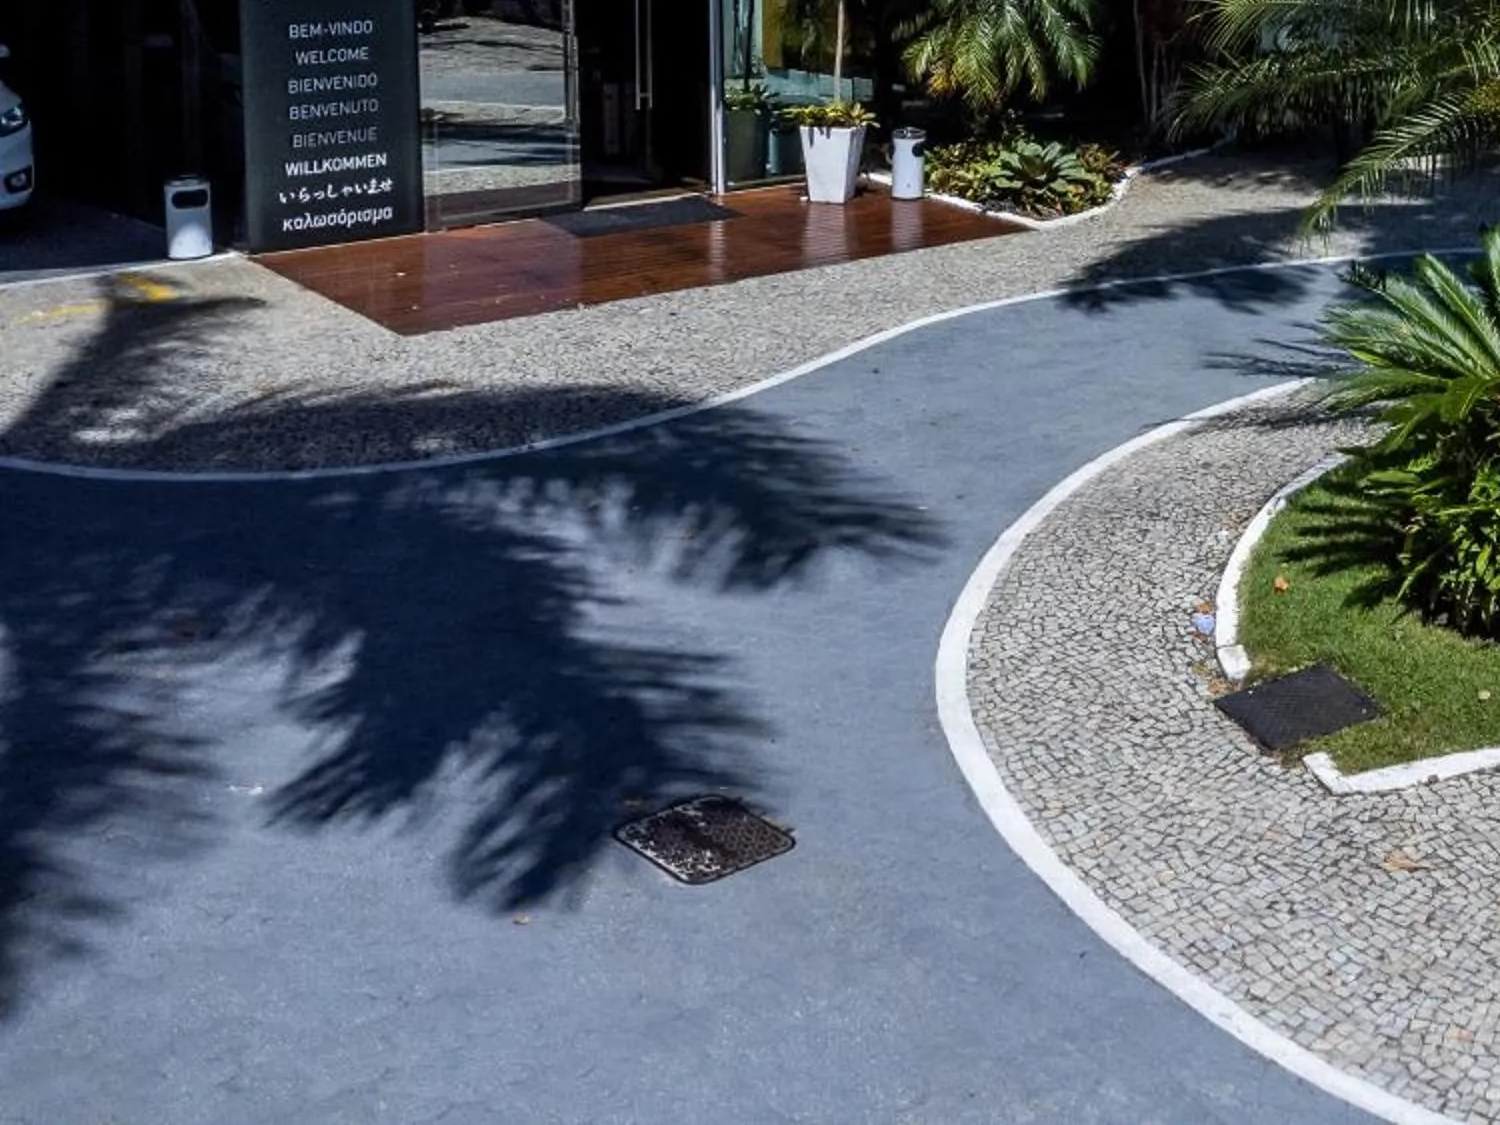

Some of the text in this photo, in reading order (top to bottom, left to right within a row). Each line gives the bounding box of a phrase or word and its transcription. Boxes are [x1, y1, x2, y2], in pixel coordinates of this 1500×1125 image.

[288, 19, 374, 39] BEM-VINDO
[295, 46, 370, 66] WELCOME
[287, 72, 379, 94] BIENVENIDO
[288, 98, 380, 120] BENVENUTO
[292, 126, 378, 148] BIENVENUE
[284, 152, 388, 177] WILLKOMMEN
[278, 177, 394, 204] いらっしゃいませ
[282, 206, 394, 232] καλωσόρισμα
